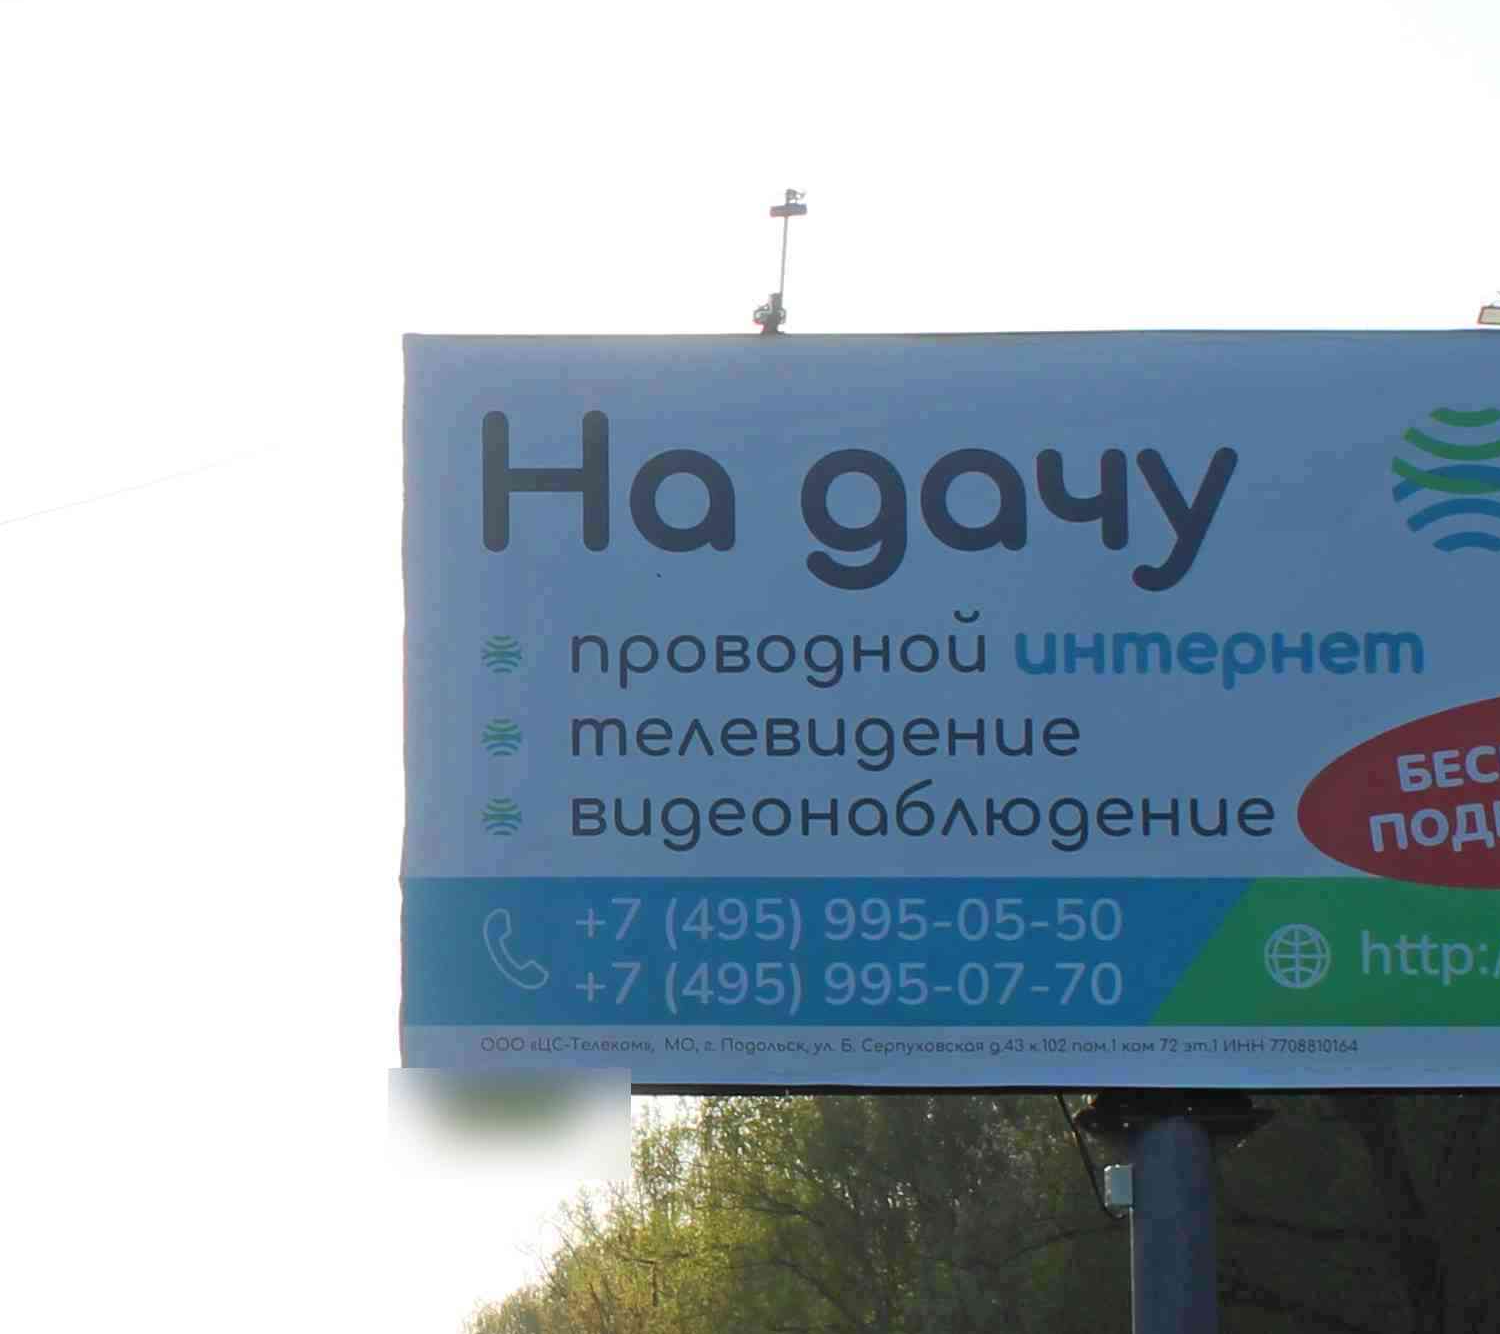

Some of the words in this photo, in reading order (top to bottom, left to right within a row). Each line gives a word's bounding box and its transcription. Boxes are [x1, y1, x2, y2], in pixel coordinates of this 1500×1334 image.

[481, 410, 736, 553] На
[800, 447, 1239, 592] дачу
[570, 609, 987, 689] проводной
[1014, 630, 1425, 691] интернет
[570, 716, 1081, 772] телевидение
[570, 778, 1275, 852] видеонаблюдение
[575, 898, 642, 941] +7
[664, 898, 802, 951] (495)
[823, 898, 1124, 941] 995-05-50
[575, 963, 642, 1006] +7
[664, 963, 802, 1016] (495)
[823, 963, 1124, 1006] 995-07-70
[480, 1037, 525, 1052] ООО
[664, 1037, 699, 1054] МО,
[721, 1037, 809, 1056] Подольск,
[861, 1038, 984, 1056] Серпуховская
[1159, 1038, 1177, 1052] 72
[1223, 1038, 1264, 1052] ИНН
